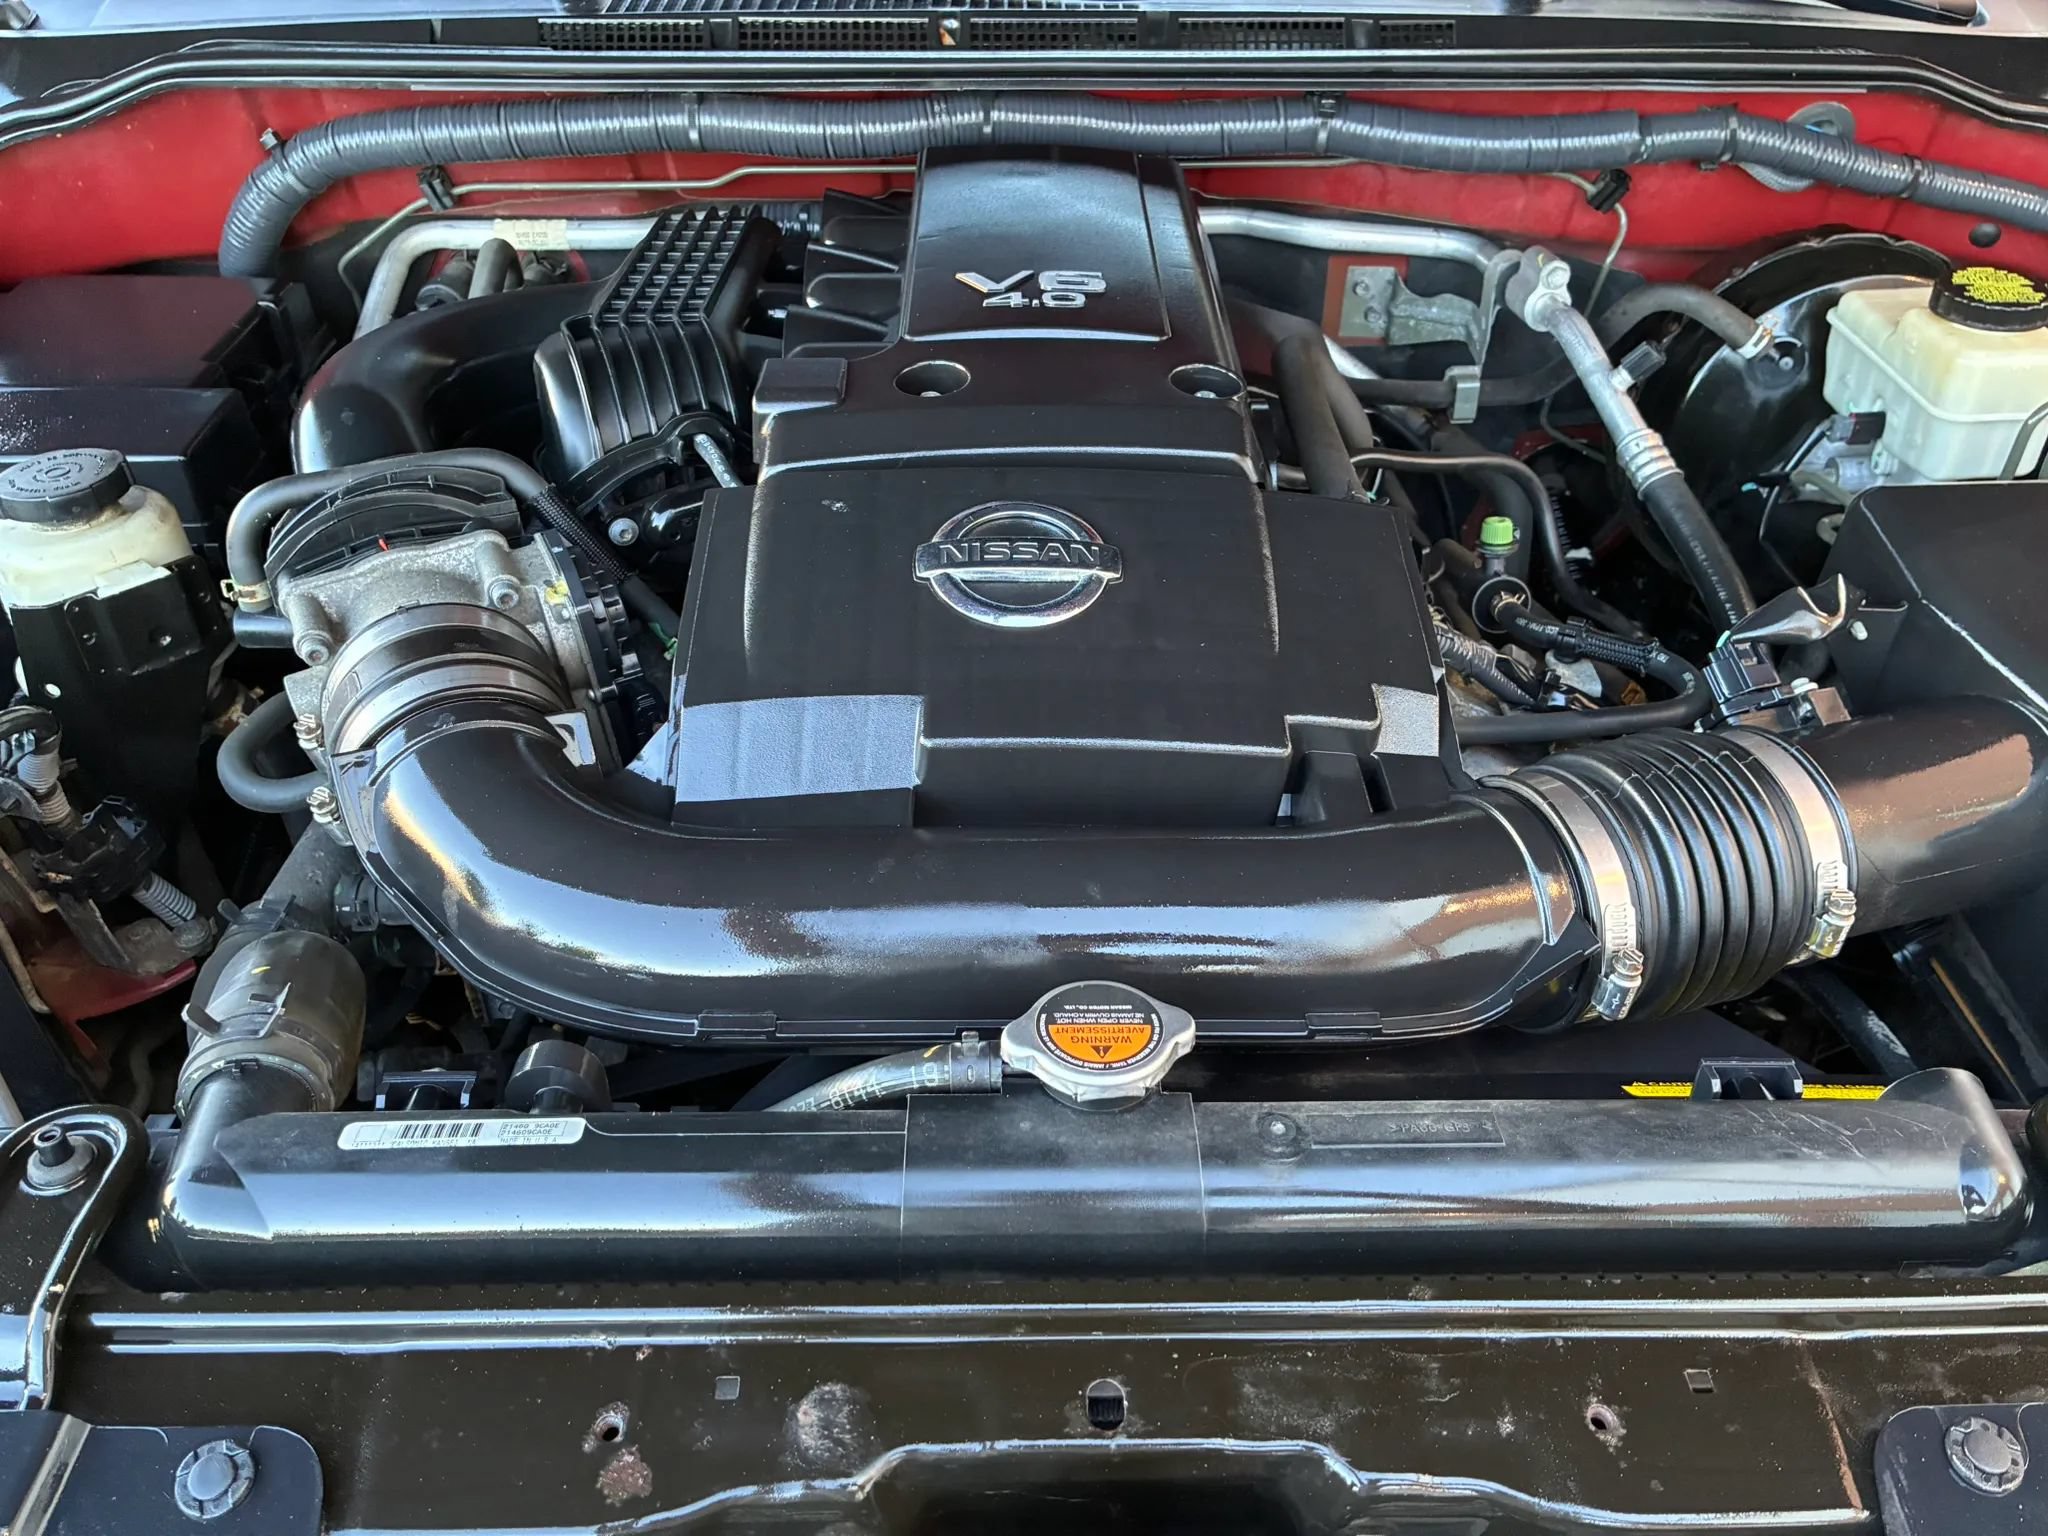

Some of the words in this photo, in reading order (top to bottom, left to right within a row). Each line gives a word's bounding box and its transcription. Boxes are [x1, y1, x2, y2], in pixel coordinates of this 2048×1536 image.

[955, 270, 1107, 293] V6
[983, 291, 1087, 308] 4.0
[939, 541, 1101, 565] NISSAN
[1054, 1026, 1145, 1034] AVERTISSEMENT
[1070, 1036, 1132, 1044] WARNING
